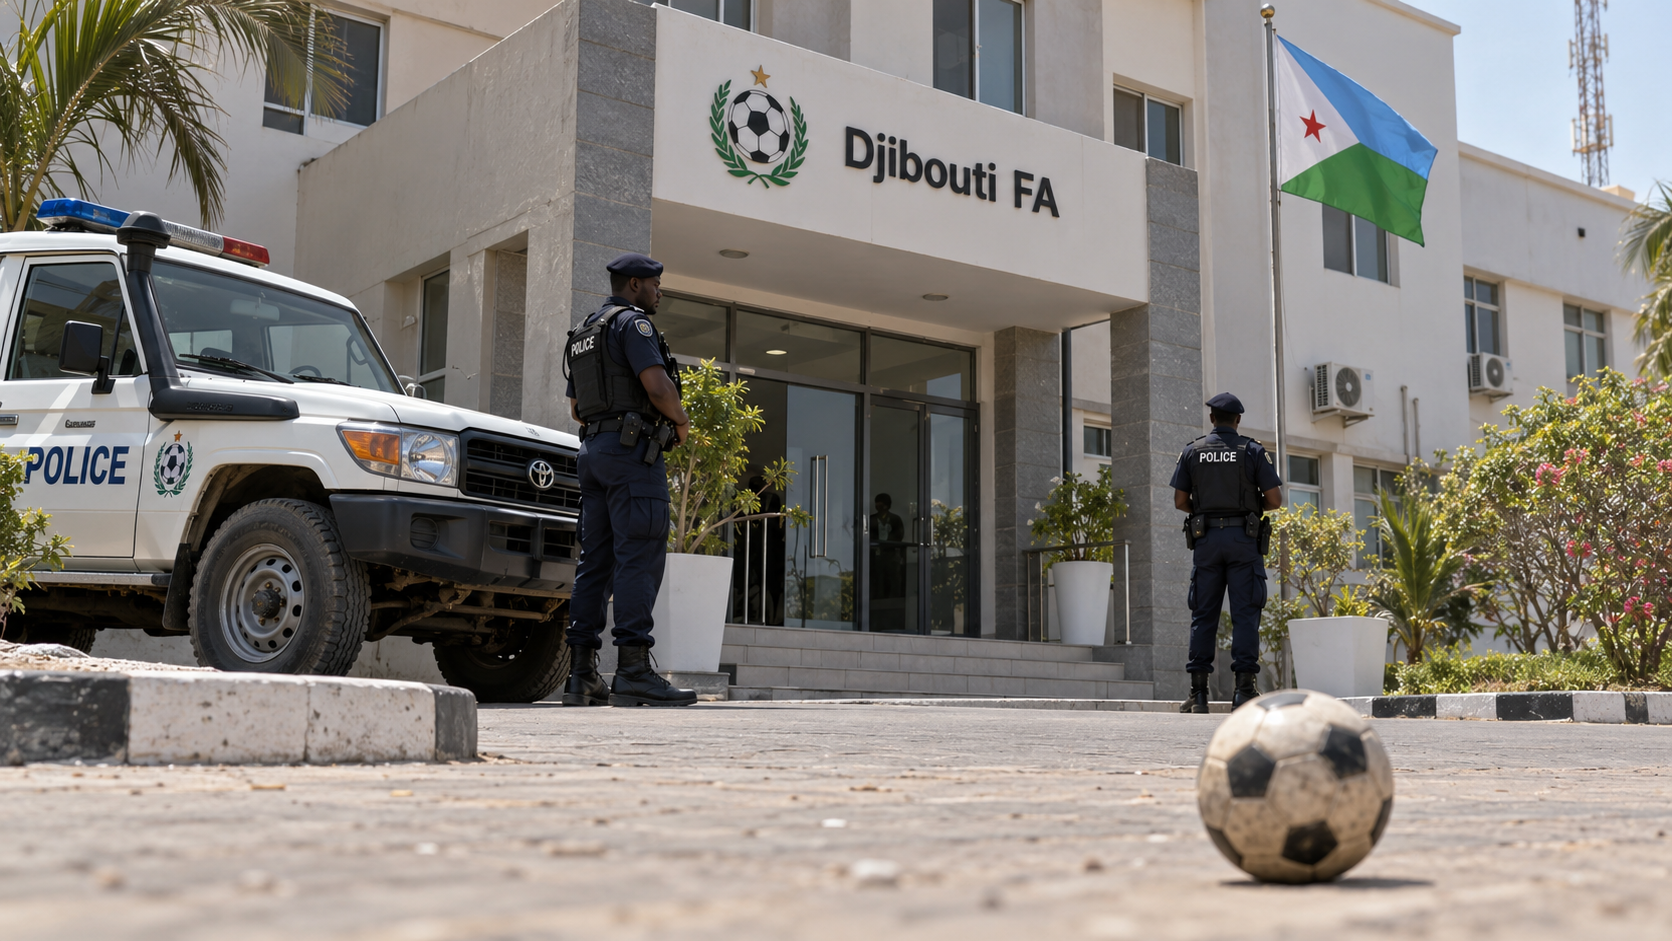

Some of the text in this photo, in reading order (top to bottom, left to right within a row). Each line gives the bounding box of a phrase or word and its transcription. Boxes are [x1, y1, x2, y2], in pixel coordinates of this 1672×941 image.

[845, 126, 1060, 218] Djibouti FA
[571, 335, 595, 357] POLICE
[24, 445, 130, 485] POLICE
[1199, 451, 1237, 463] POLICE
